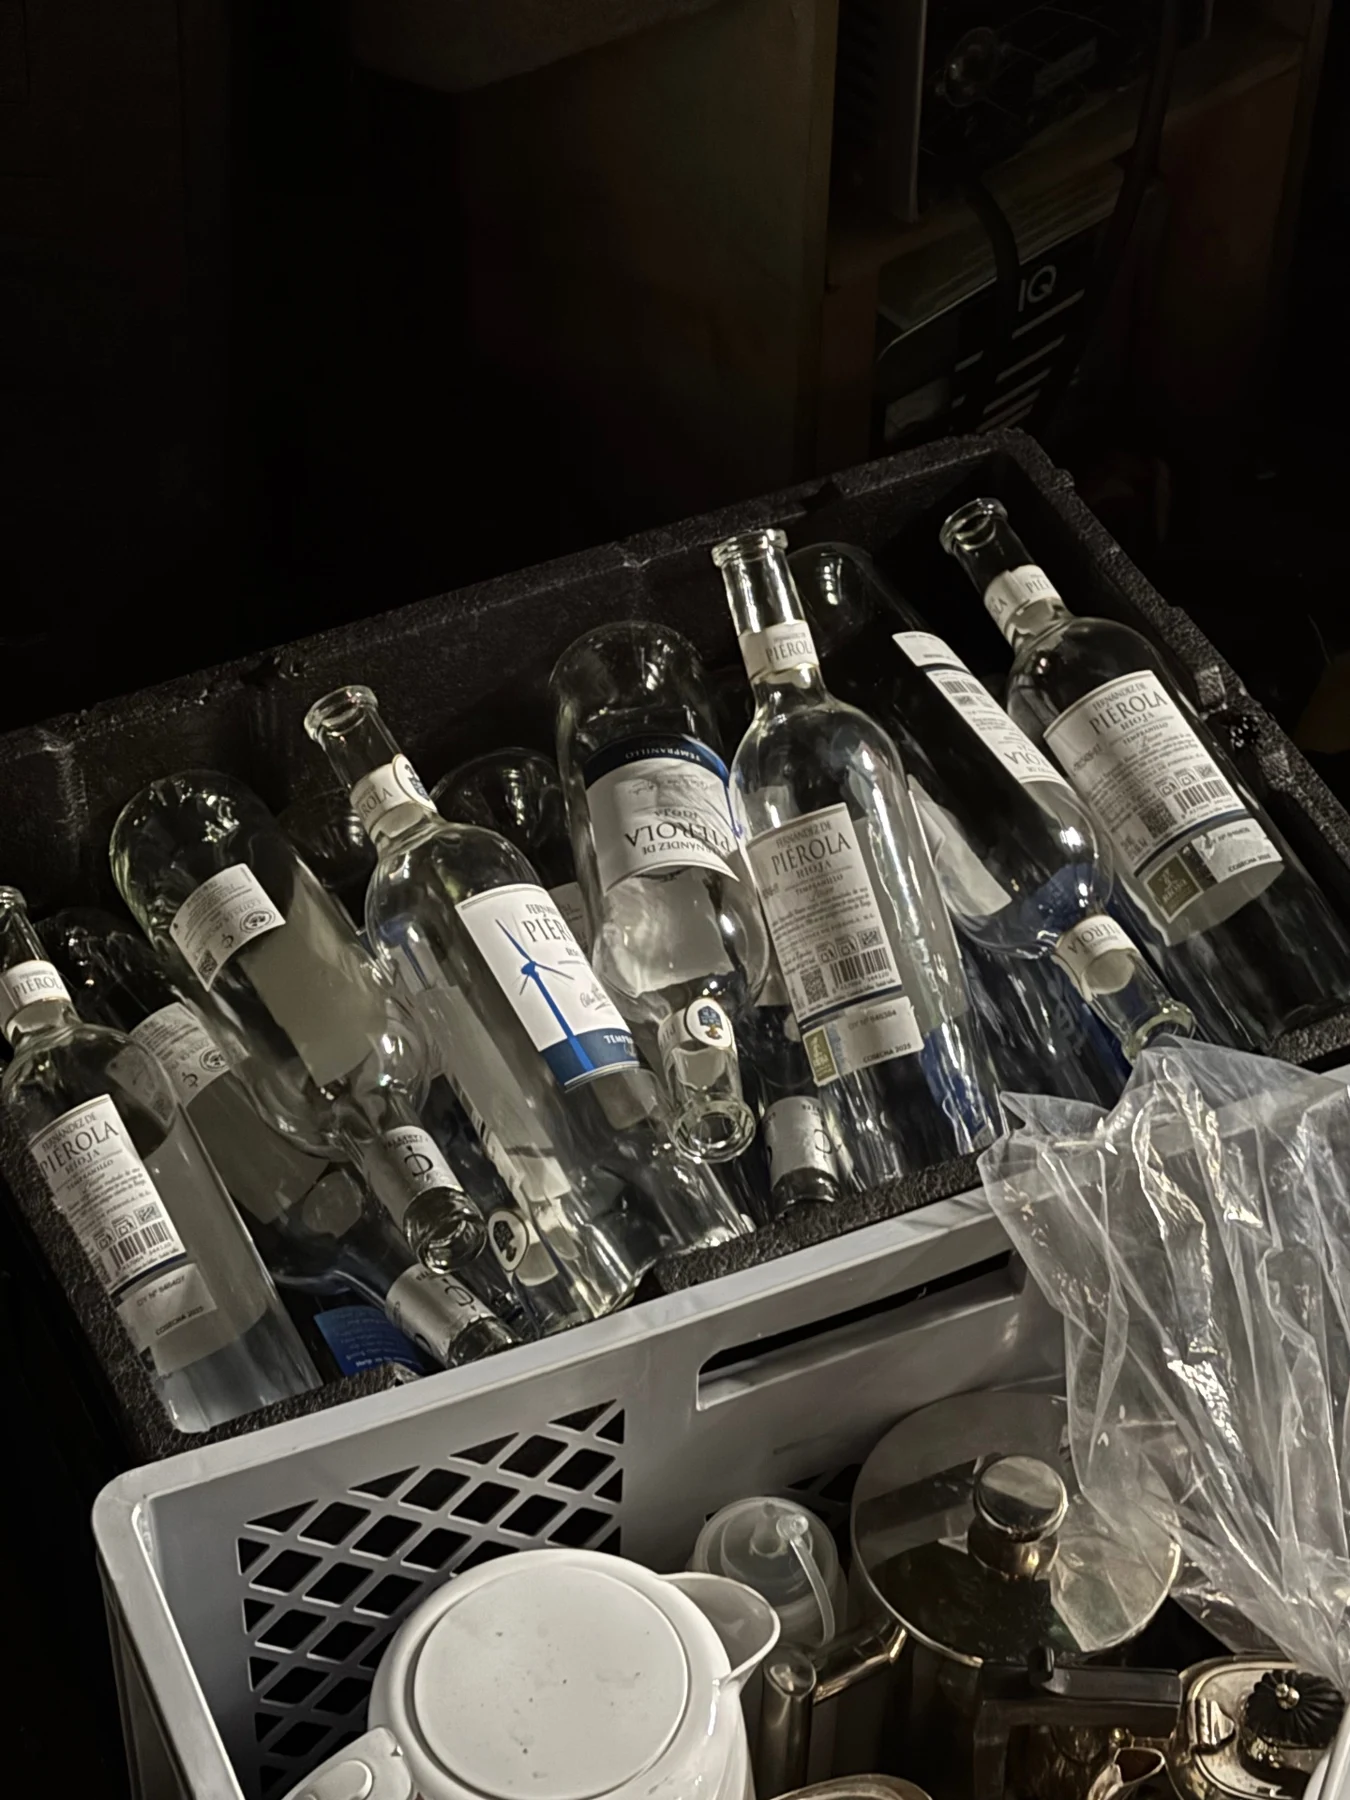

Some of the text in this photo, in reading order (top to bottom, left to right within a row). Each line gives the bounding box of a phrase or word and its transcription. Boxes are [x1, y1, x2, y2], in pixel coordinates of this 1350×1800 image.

[1018, 264, 1057, 312] IQ
[770, 831, 852, 876] PIÉROLA
[39, 1120, 119, 1178] PIÉROLA
